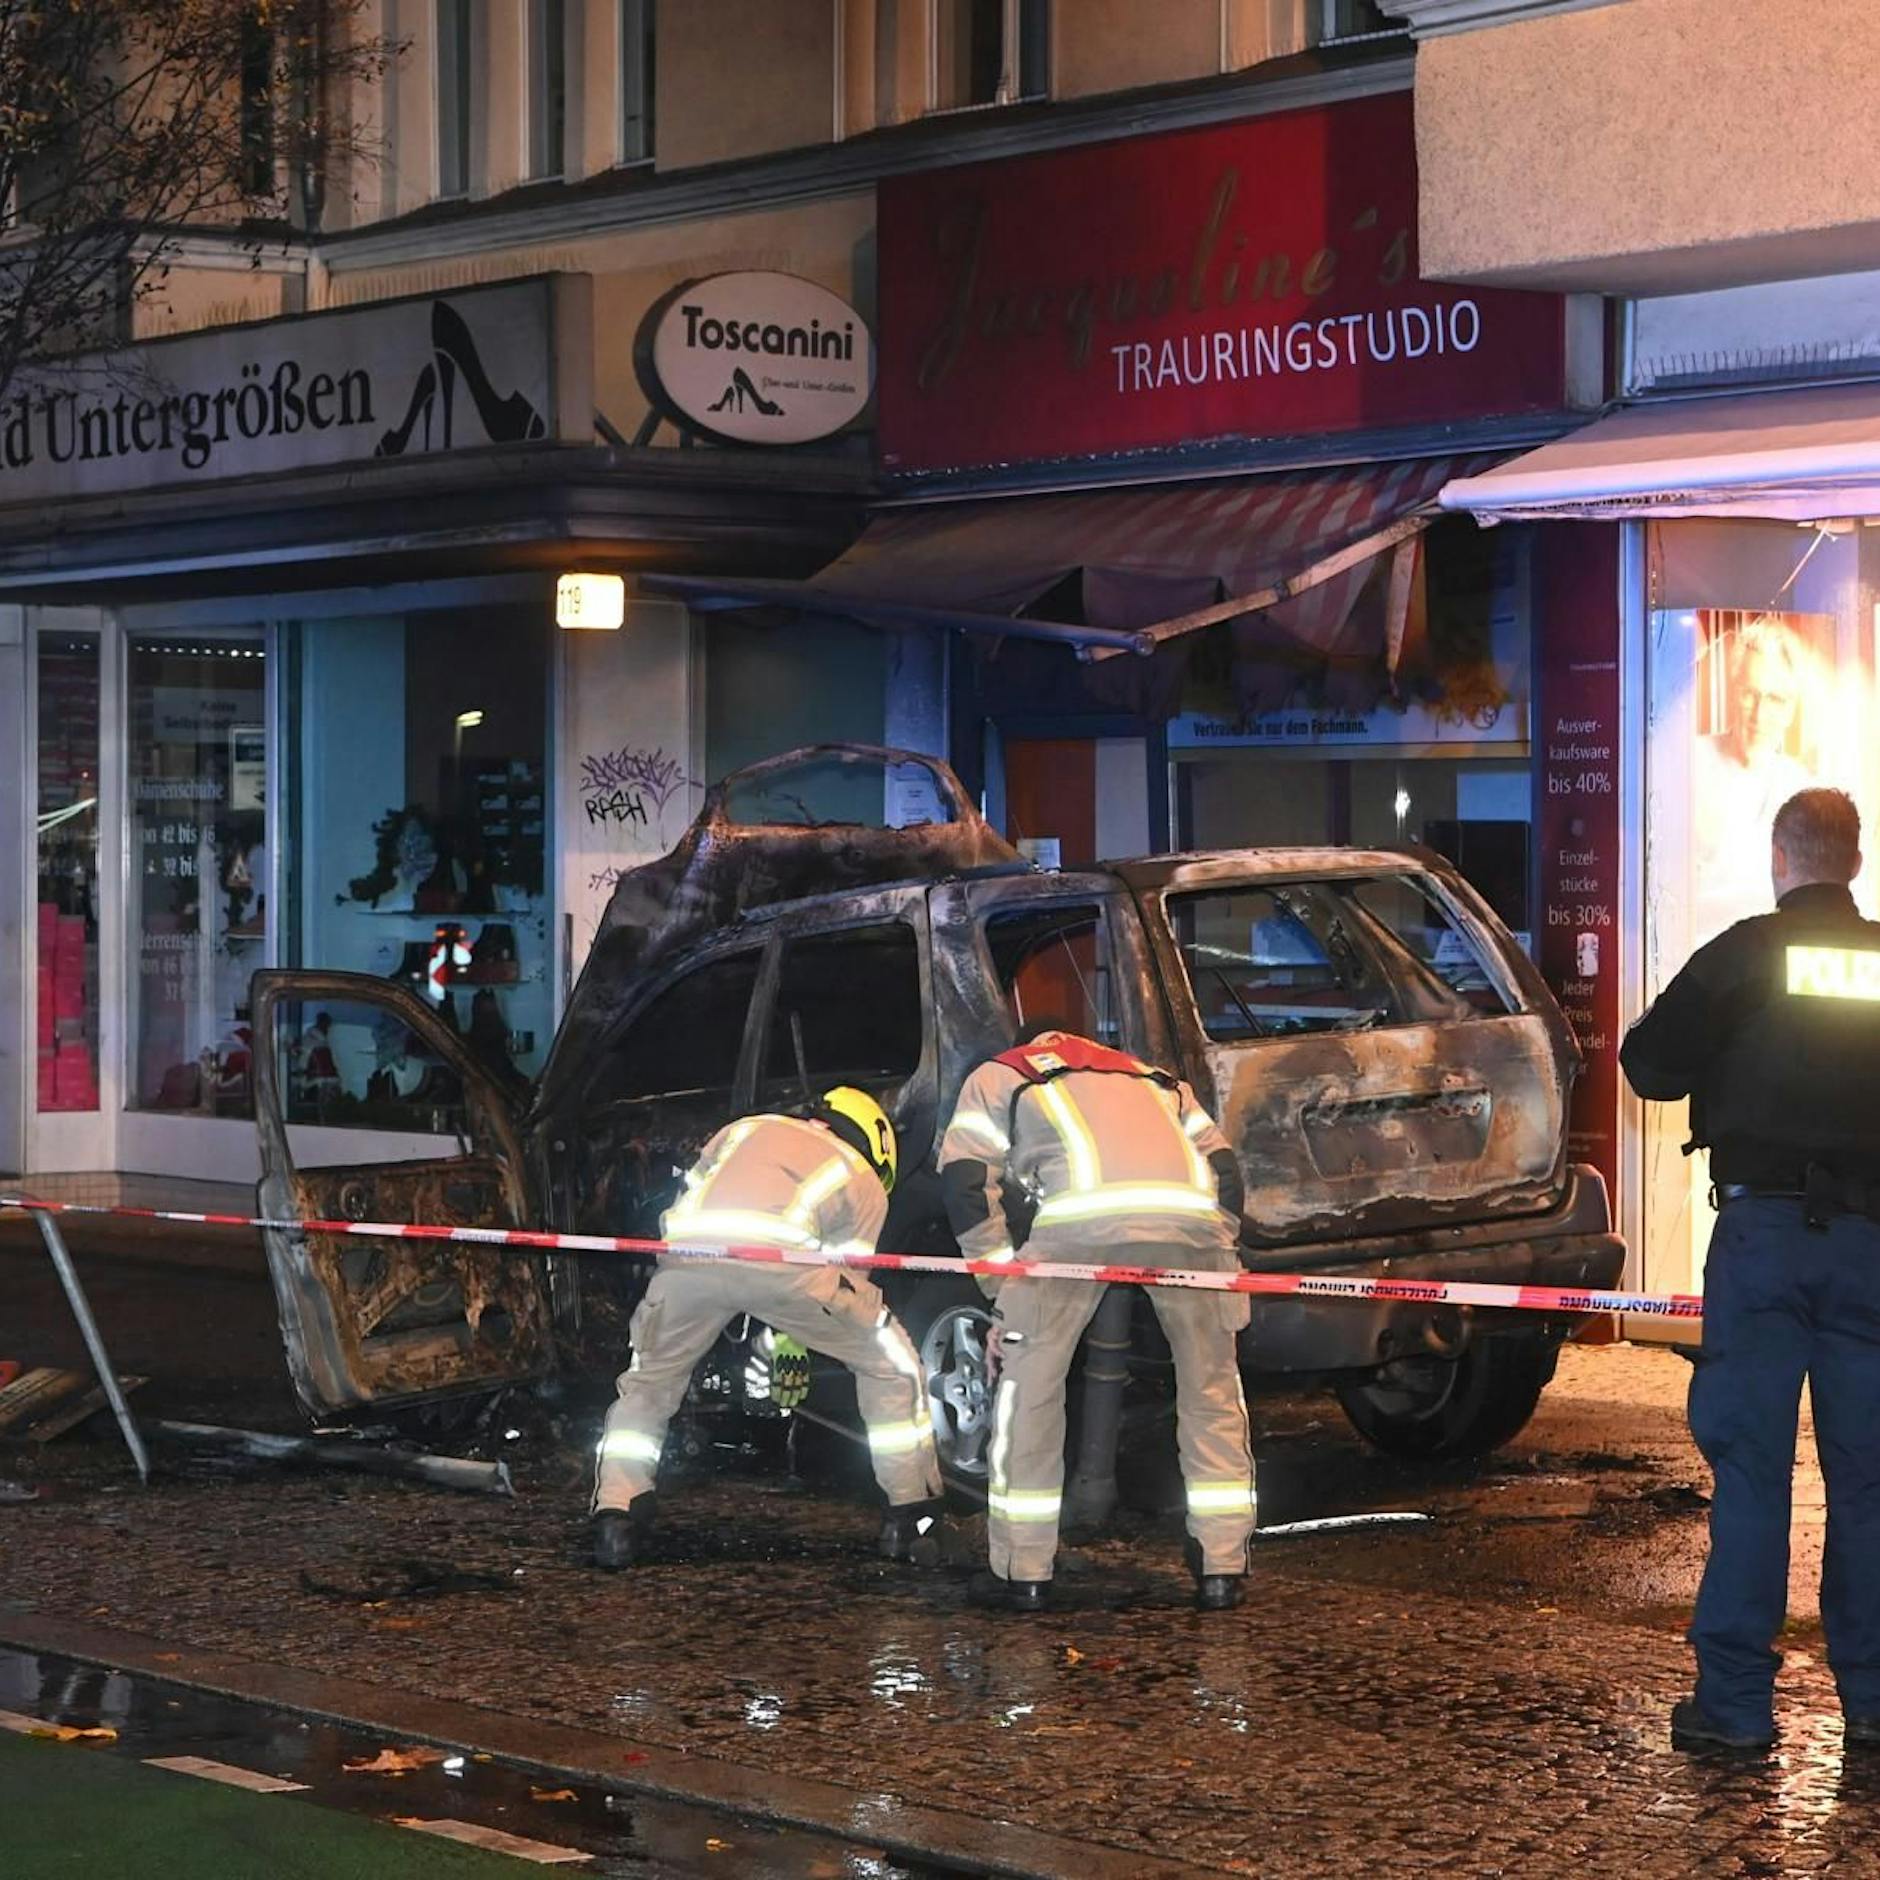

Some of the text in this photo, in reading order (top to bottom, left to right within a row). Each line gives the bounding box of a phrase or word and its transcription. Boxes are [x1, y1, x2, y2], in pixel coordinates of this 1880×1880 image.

[681, 305, 854, 361] Toscanini
[1112, 299, 1480, 393] TRAURINGSTUDIO
[47, 360, 376, 469] Untergrößen
[1311, 717, 1368, 735] Fachmann.
[1556, 718, 1602, 734] Ausver-
[1549, 743, 1611, 761] kaufsware
[1548, 772, 1612, 794] bis 40%
[178, 822, 198, 844] bis
[1559, 849, 1599, 867] Einzel-
[1559, 875, 1599, 893] stücke
[1548, 904, 1612, 926] bis 30%
